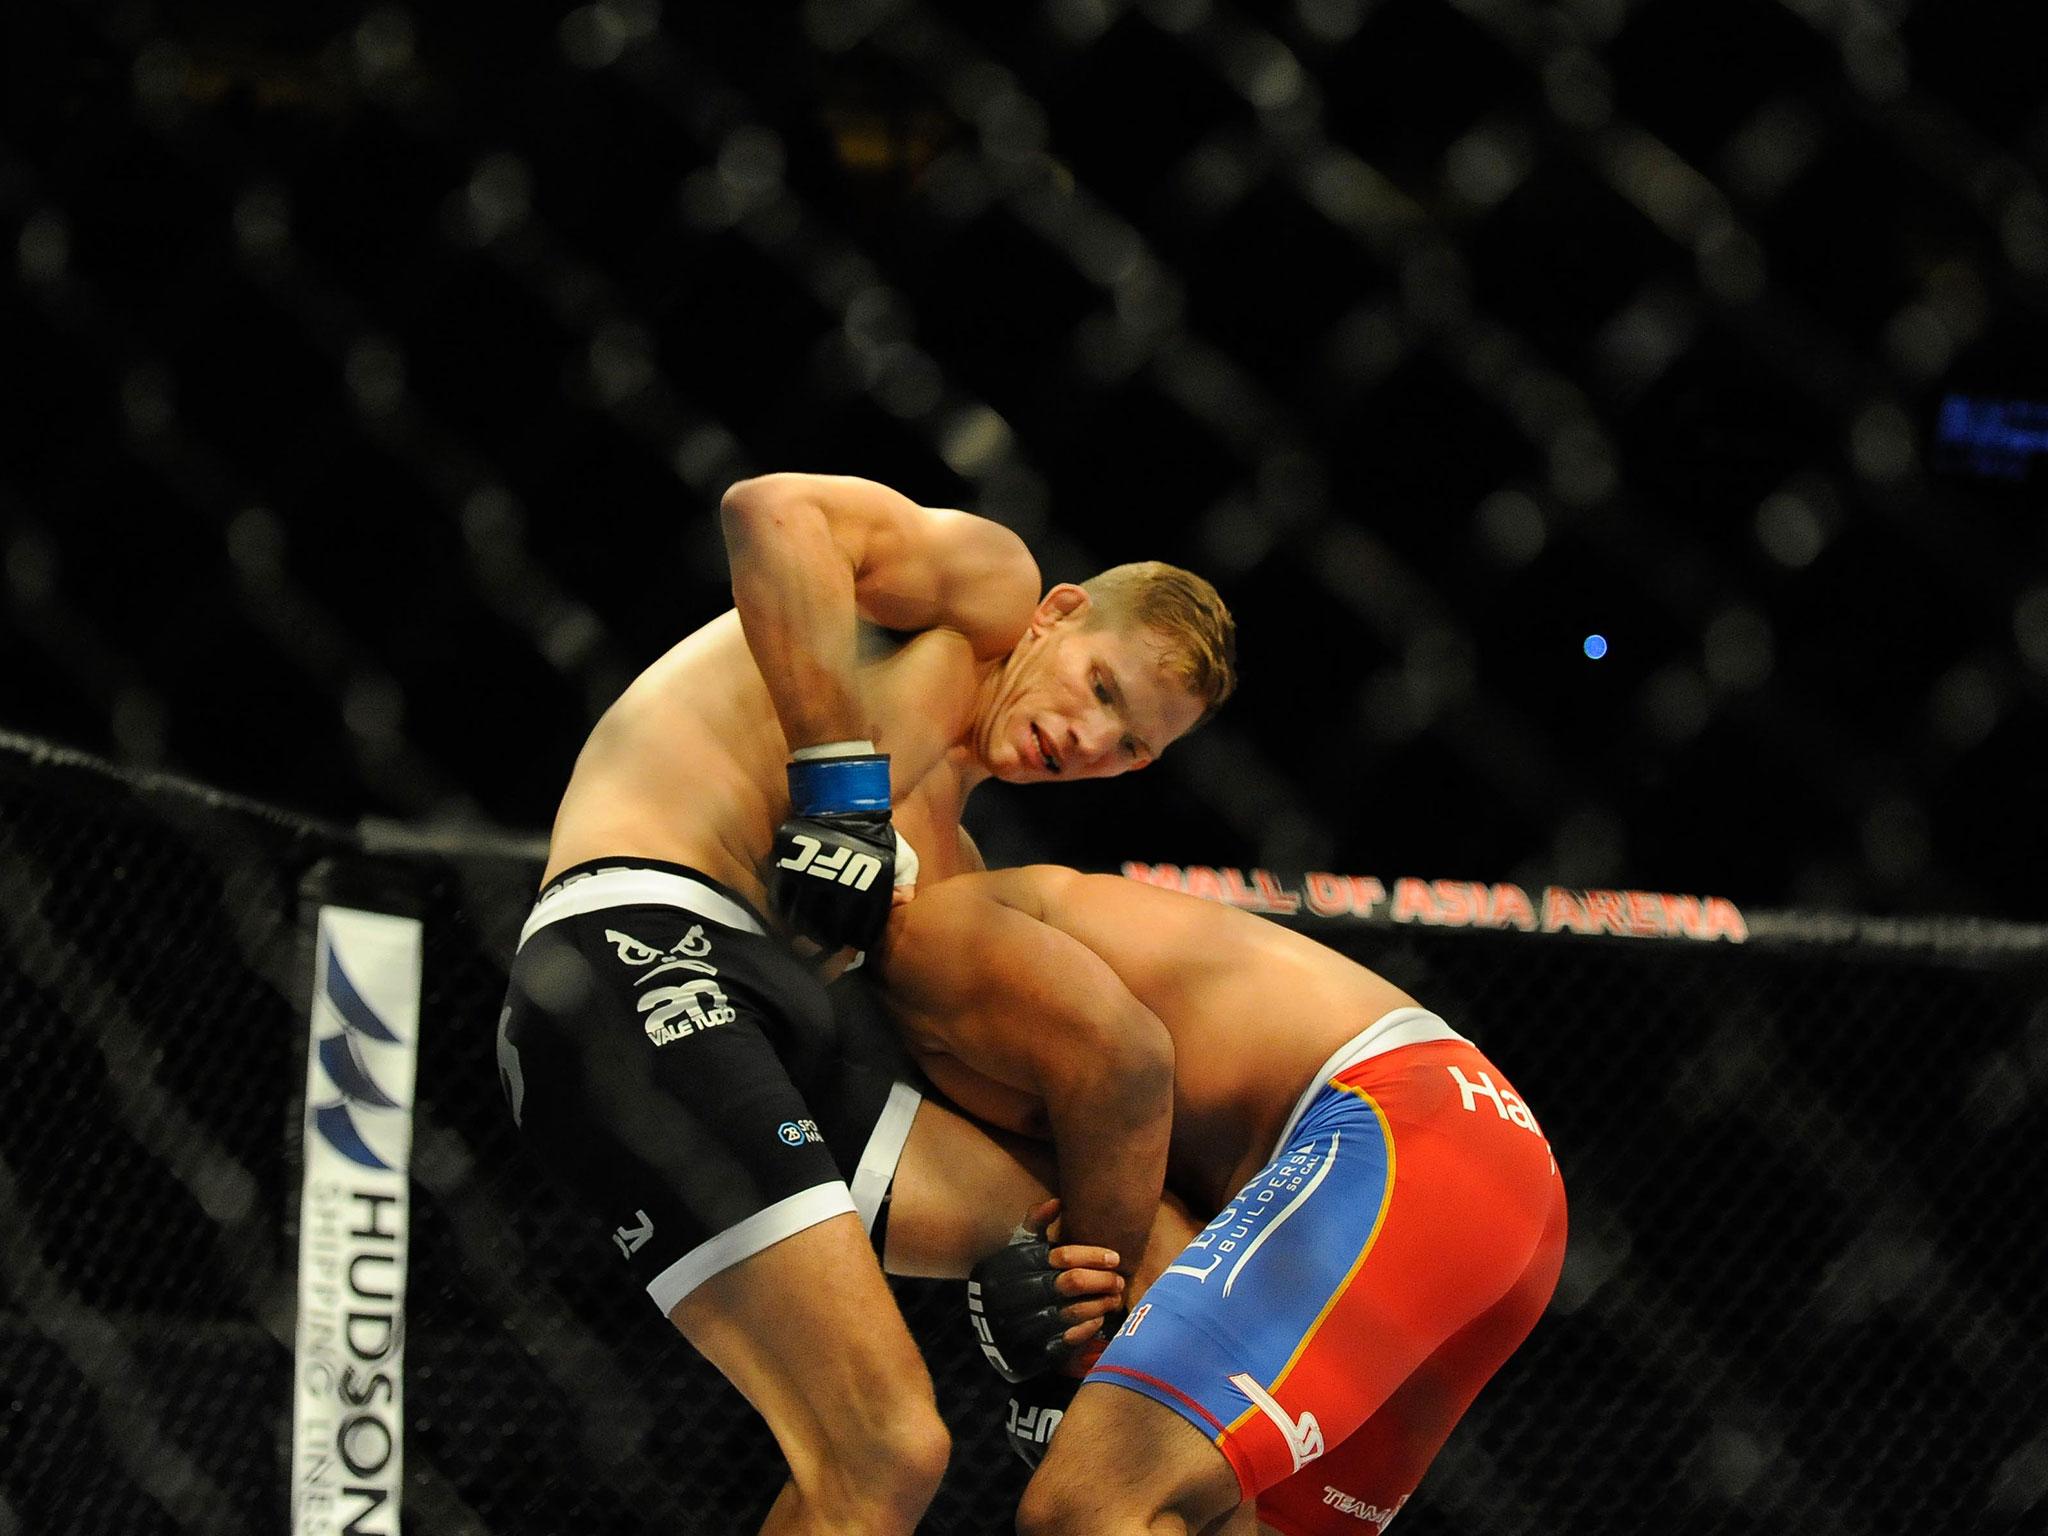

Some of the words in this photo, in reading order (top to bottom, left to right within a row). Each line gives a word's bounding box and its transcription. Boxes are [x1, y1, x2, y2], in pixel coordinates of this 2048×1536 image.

[776, 834, 882, 893] UFC
[1304, 871, 1387, 919] OF
[1389, 876, 1538, 933] ASIA
[1540, 884, 1751, 944] ARENA
[647, 1019, 694, 1048] VALE
[690, 1007, 736, 1031] TUDO
[1220, 1153, 1305, 1253] BUILDERS
[1286, 1177, 1301, 1192] SO
[1300, 1155, 1320, 1175] CAL
[336, 1192, 397, 1536] HUDSON
